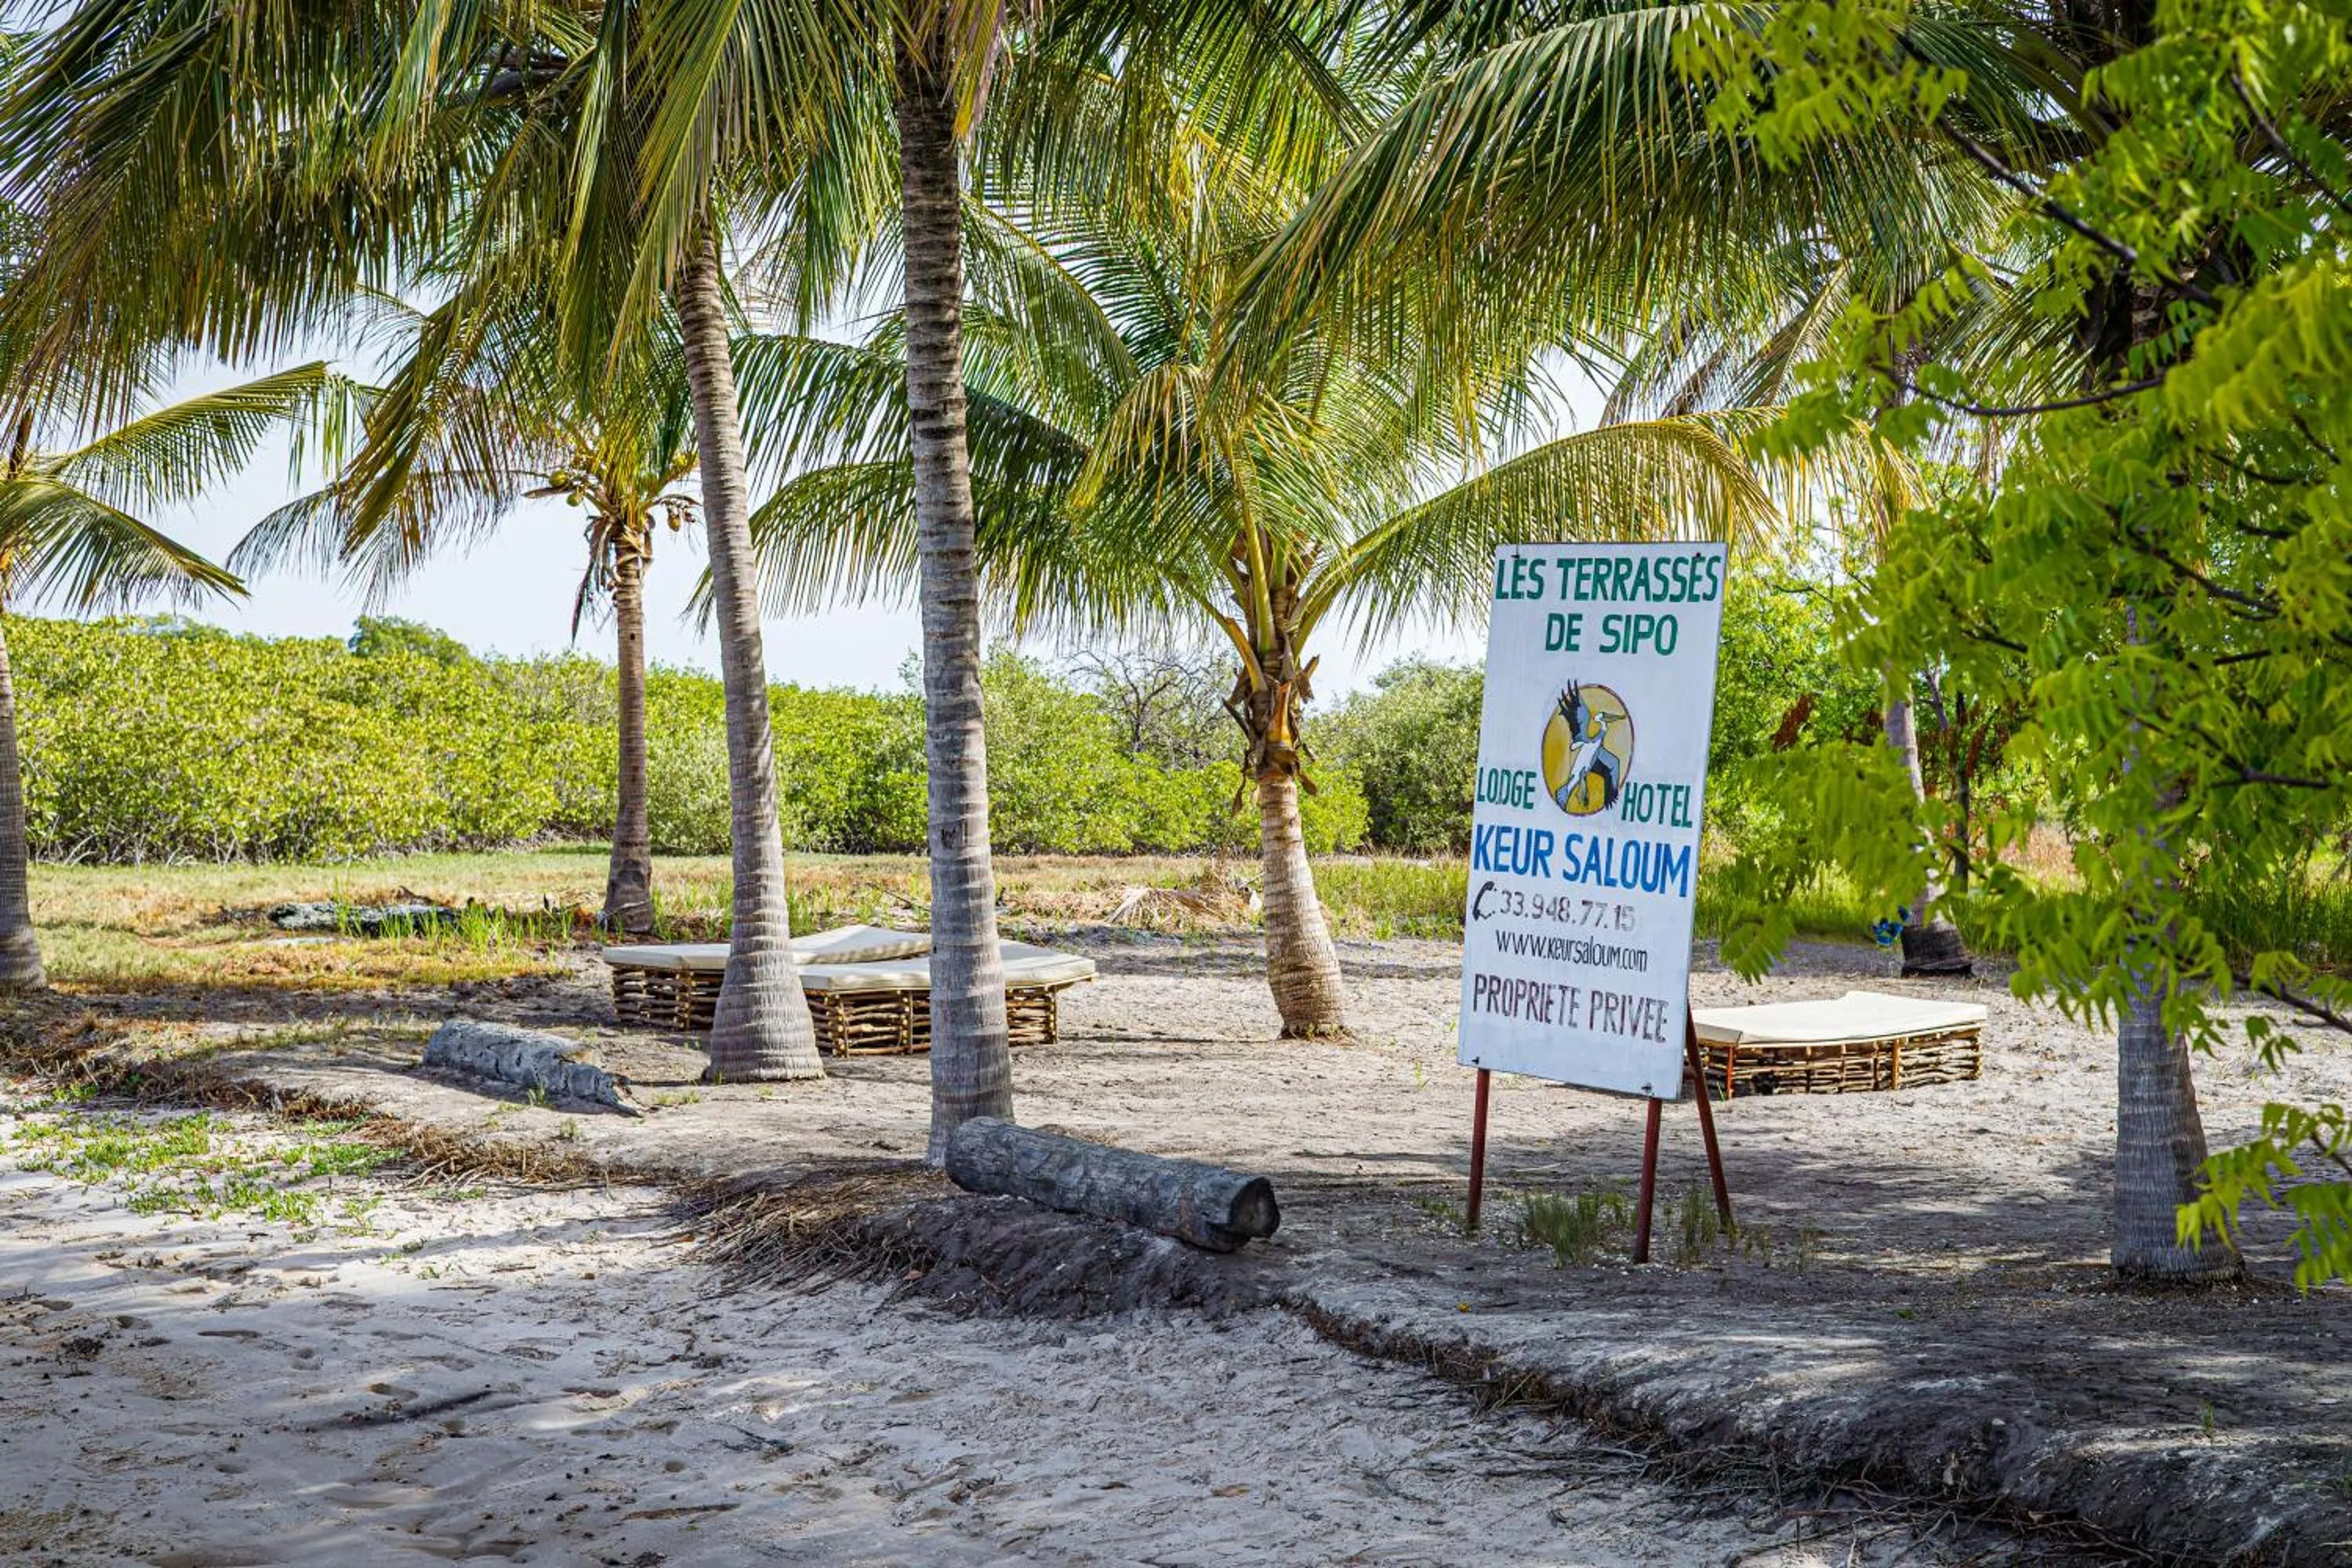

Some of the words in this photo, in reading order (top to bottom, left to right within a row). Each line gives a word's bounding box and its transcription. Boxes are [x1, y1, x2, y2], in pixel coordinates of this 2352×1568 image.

[1495, 557, 1547, 601] LES
[1557, 555, 1722, 603] TERRASSES
[1545, 612, 1583, 652] DE
[1599, 614, 1679, 655] SIPO
[1476, 767, 1537, 810] LODGE
[1621, 782, 1693, 828] HOTEL
[1473, 824, 1555, 879] KEUR
[1562, 833, 1691, 898] SALOUM
[1472, 973, 1581, 1029] PROPRIETE
[1588, 989, 1669, 1043] PRIVEE
